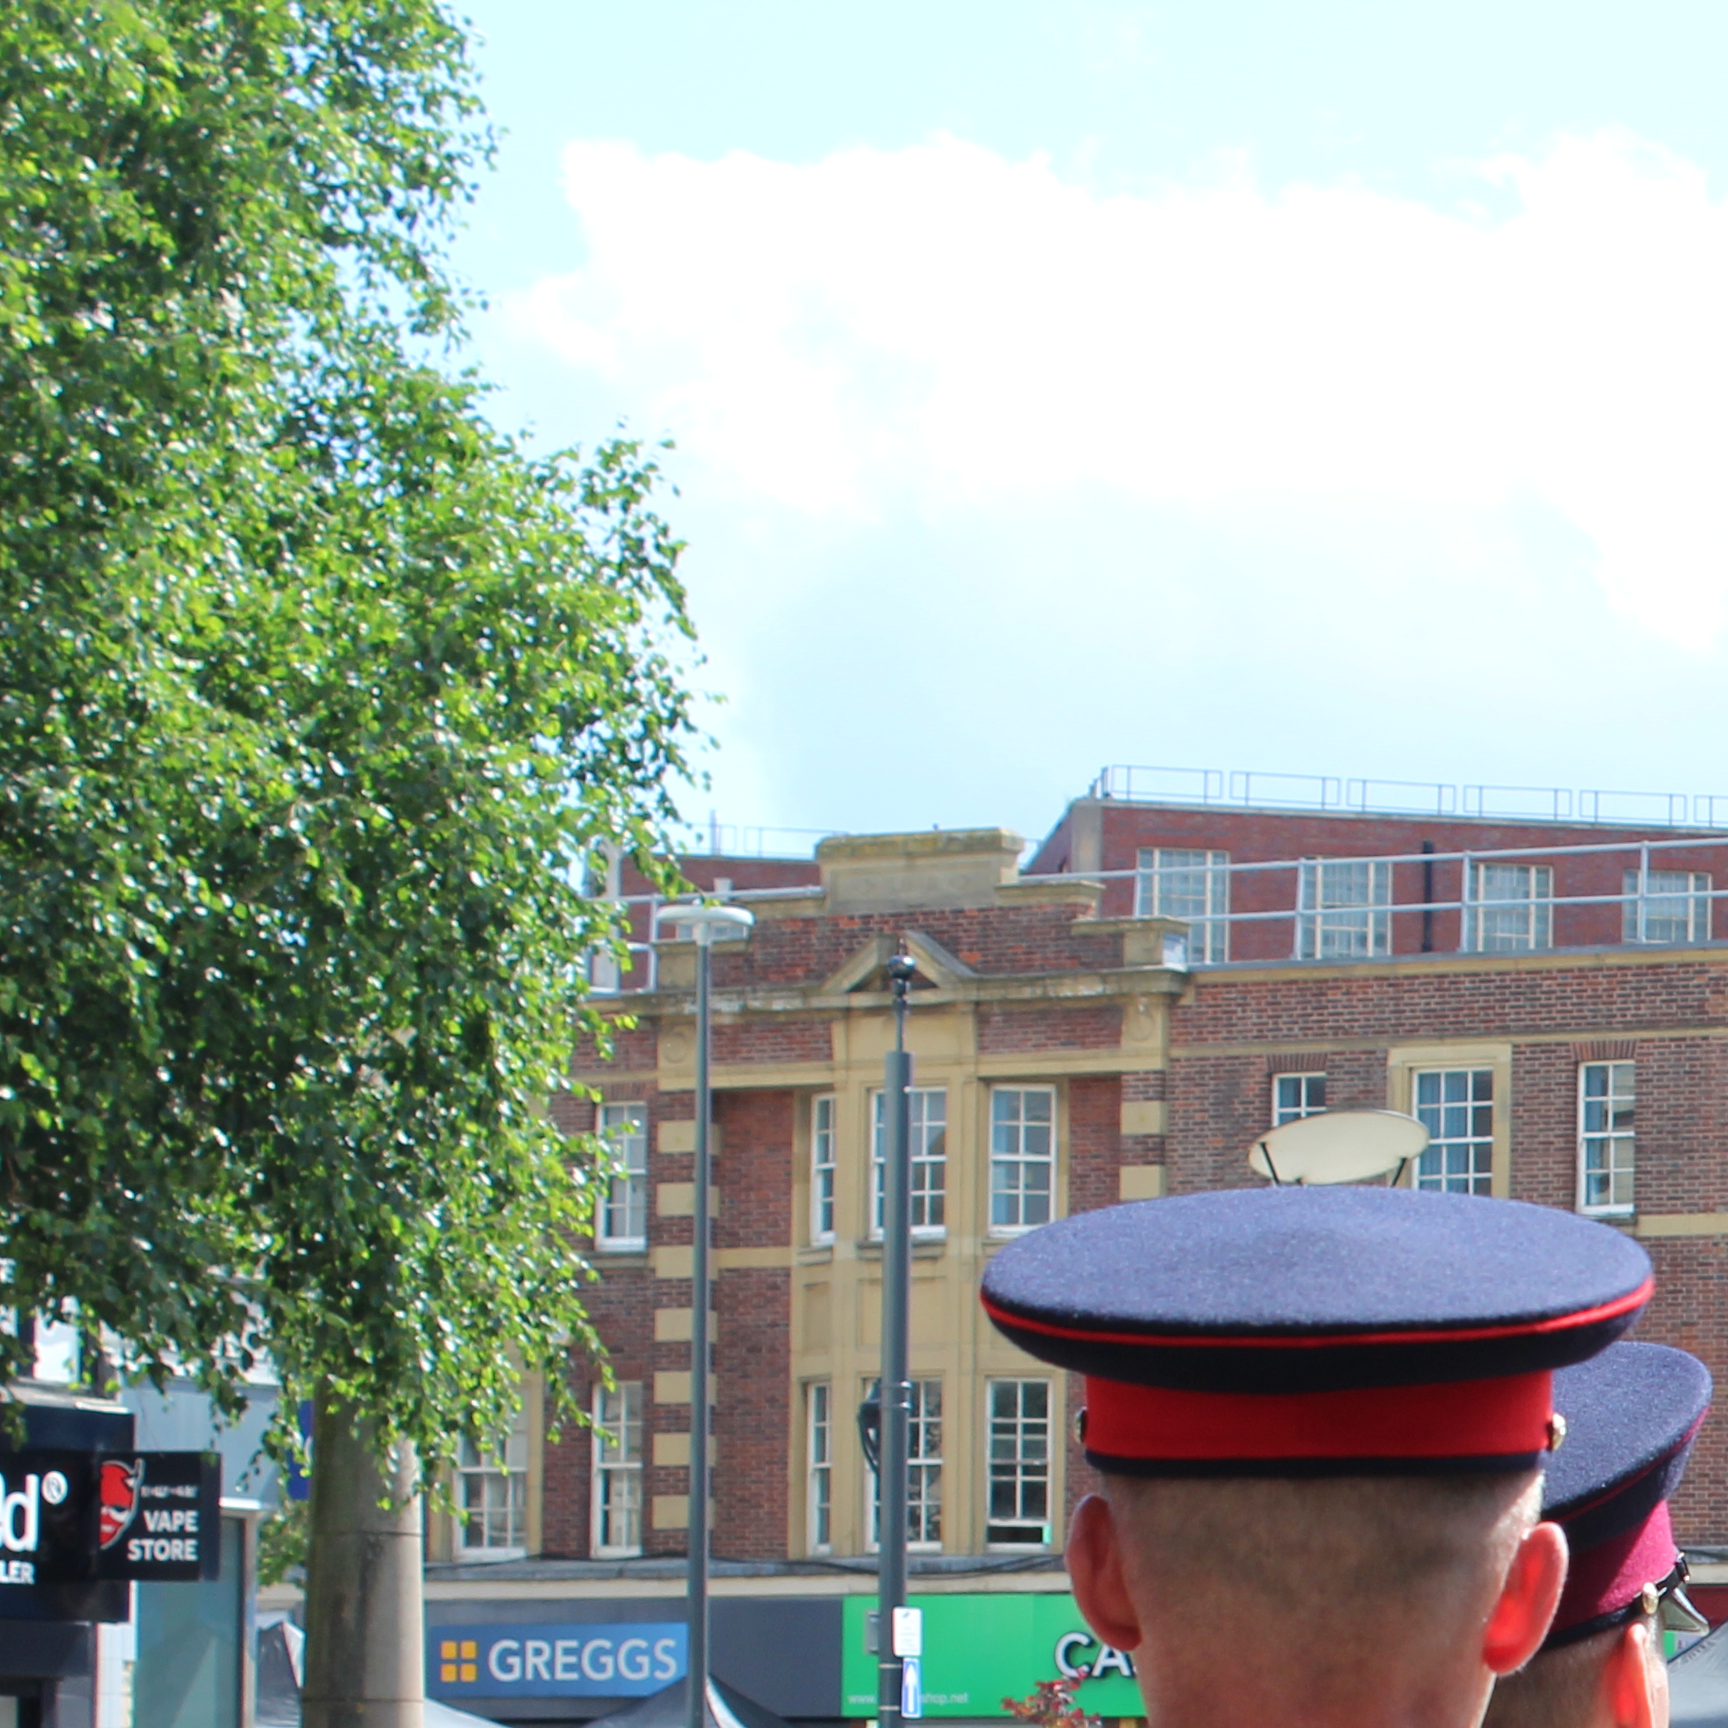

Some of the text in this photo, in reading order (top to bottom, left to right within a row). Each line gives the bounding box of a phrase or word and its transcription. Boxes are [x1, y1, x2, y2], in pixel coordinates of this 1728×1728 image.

[143, 1510, 199, 1533] VAPE
[127, 1538, 199, 1562] STORE
[487, 1638, 678, 1682] GREGGS
[1054, 1631, 1136, 1678] CA
